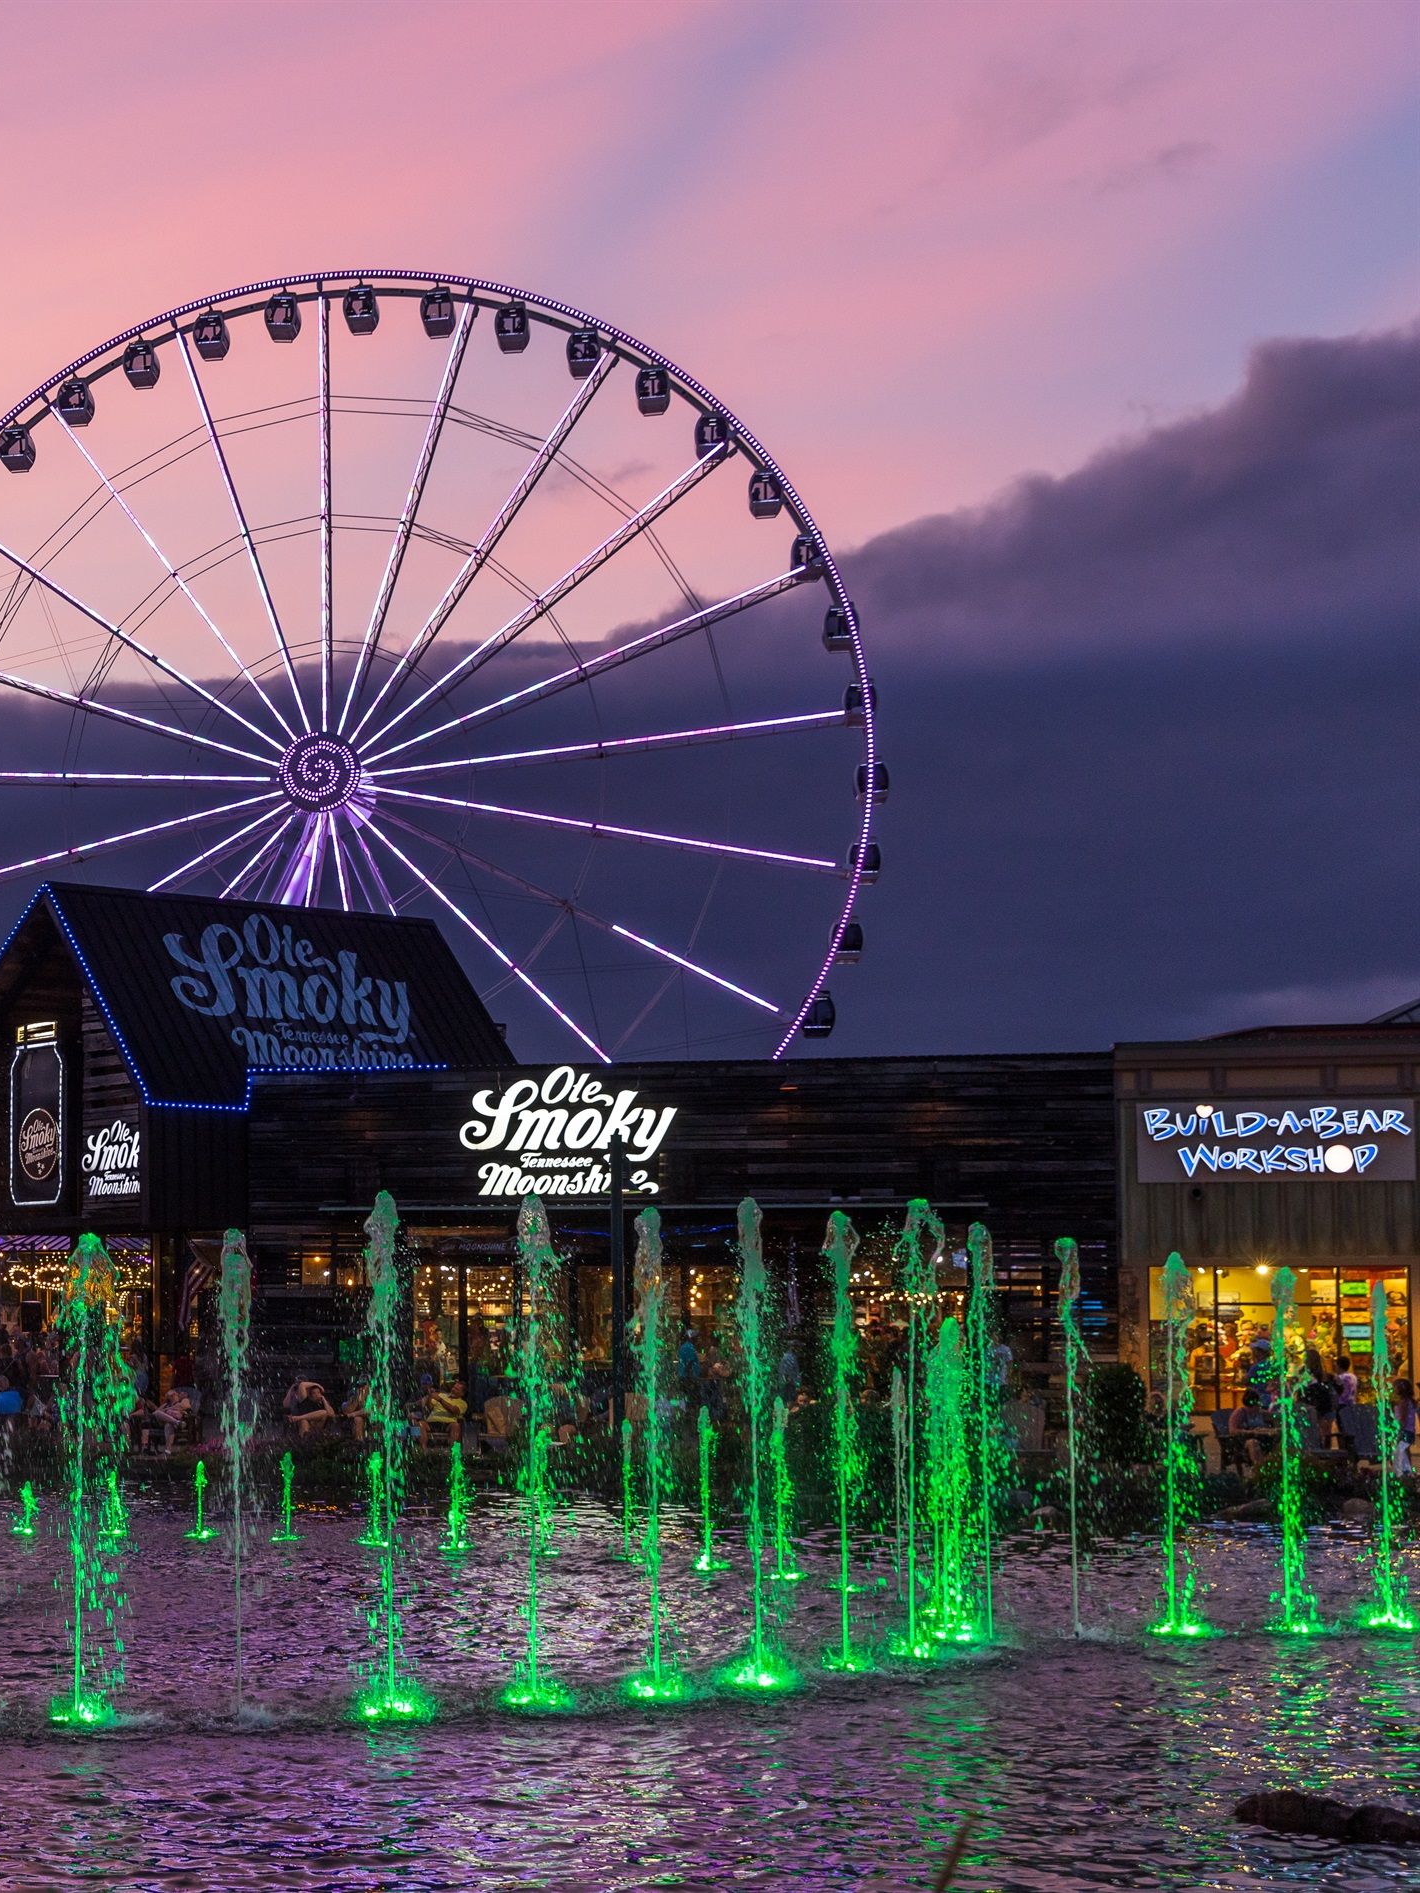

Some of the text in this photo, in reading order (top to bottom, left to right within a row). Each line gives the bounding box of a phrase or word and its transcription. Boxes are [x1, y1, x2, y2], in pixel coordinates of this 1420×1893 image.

[243, 913, 336, 973] Ole
[163, 923, 410, 1044] Smoky
[231, 1026, 414, 1067] Moonshine
[274, 1022, 349, 1044] Tennessee
[541, 1066, 614, 1106] Ole
[21, 1122, 56, 1152] Smoky
[111, 1120, 133, 1143] Ole
[459, 1079, 678, 1162] Smoky
[82, 1128, 140, 1172] Smok
[520, 1152, 593, 1168] Tennessee
[1177, 1143, 1378, 1177] WORKSHOP
[89, 1175, 140, 1196] Moonshin
[478, 1162, 659, 1196] Moonshie
